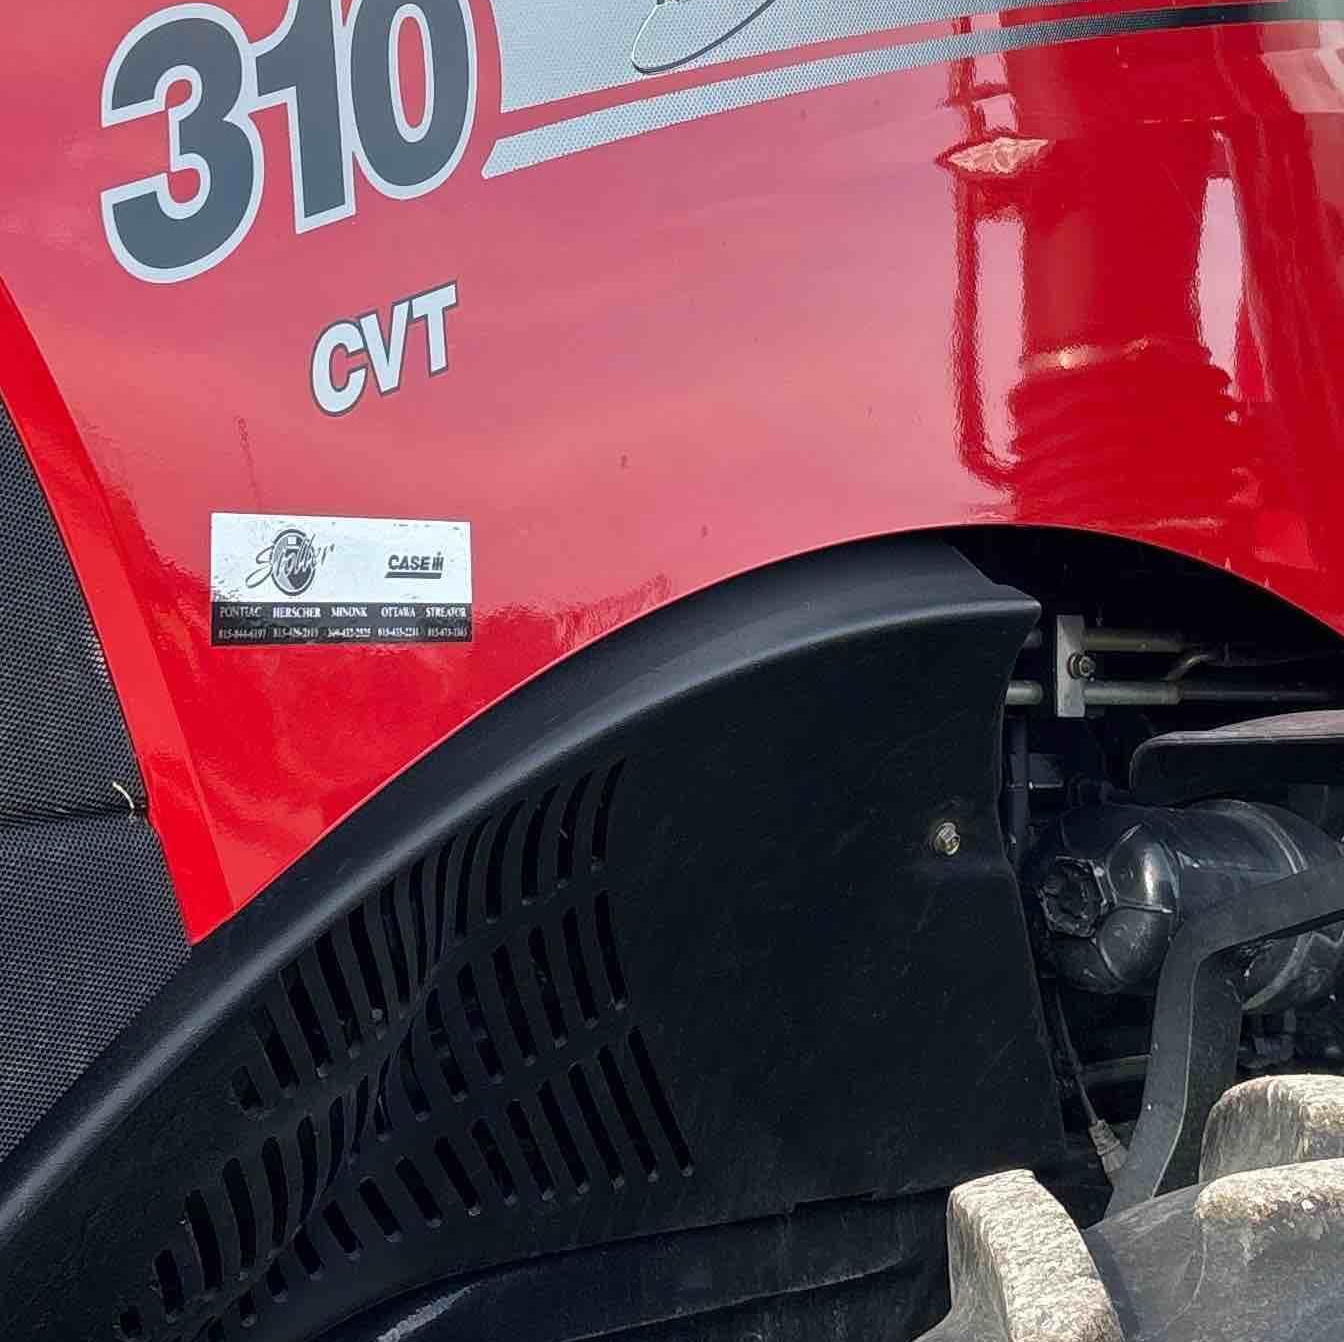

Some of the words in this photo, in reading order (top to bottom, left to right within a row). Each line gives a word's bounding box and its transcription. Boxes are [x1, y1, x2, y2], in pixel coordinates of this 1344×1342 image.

[310, 281, 457, 416] CVT
[219, 606, 263, 619] PONTIAC
[272, 606, 321, 619] HERSCHER
[381, 606, 416, 618] OTTAWA
[425, 606, 467, 619] STREATOR
